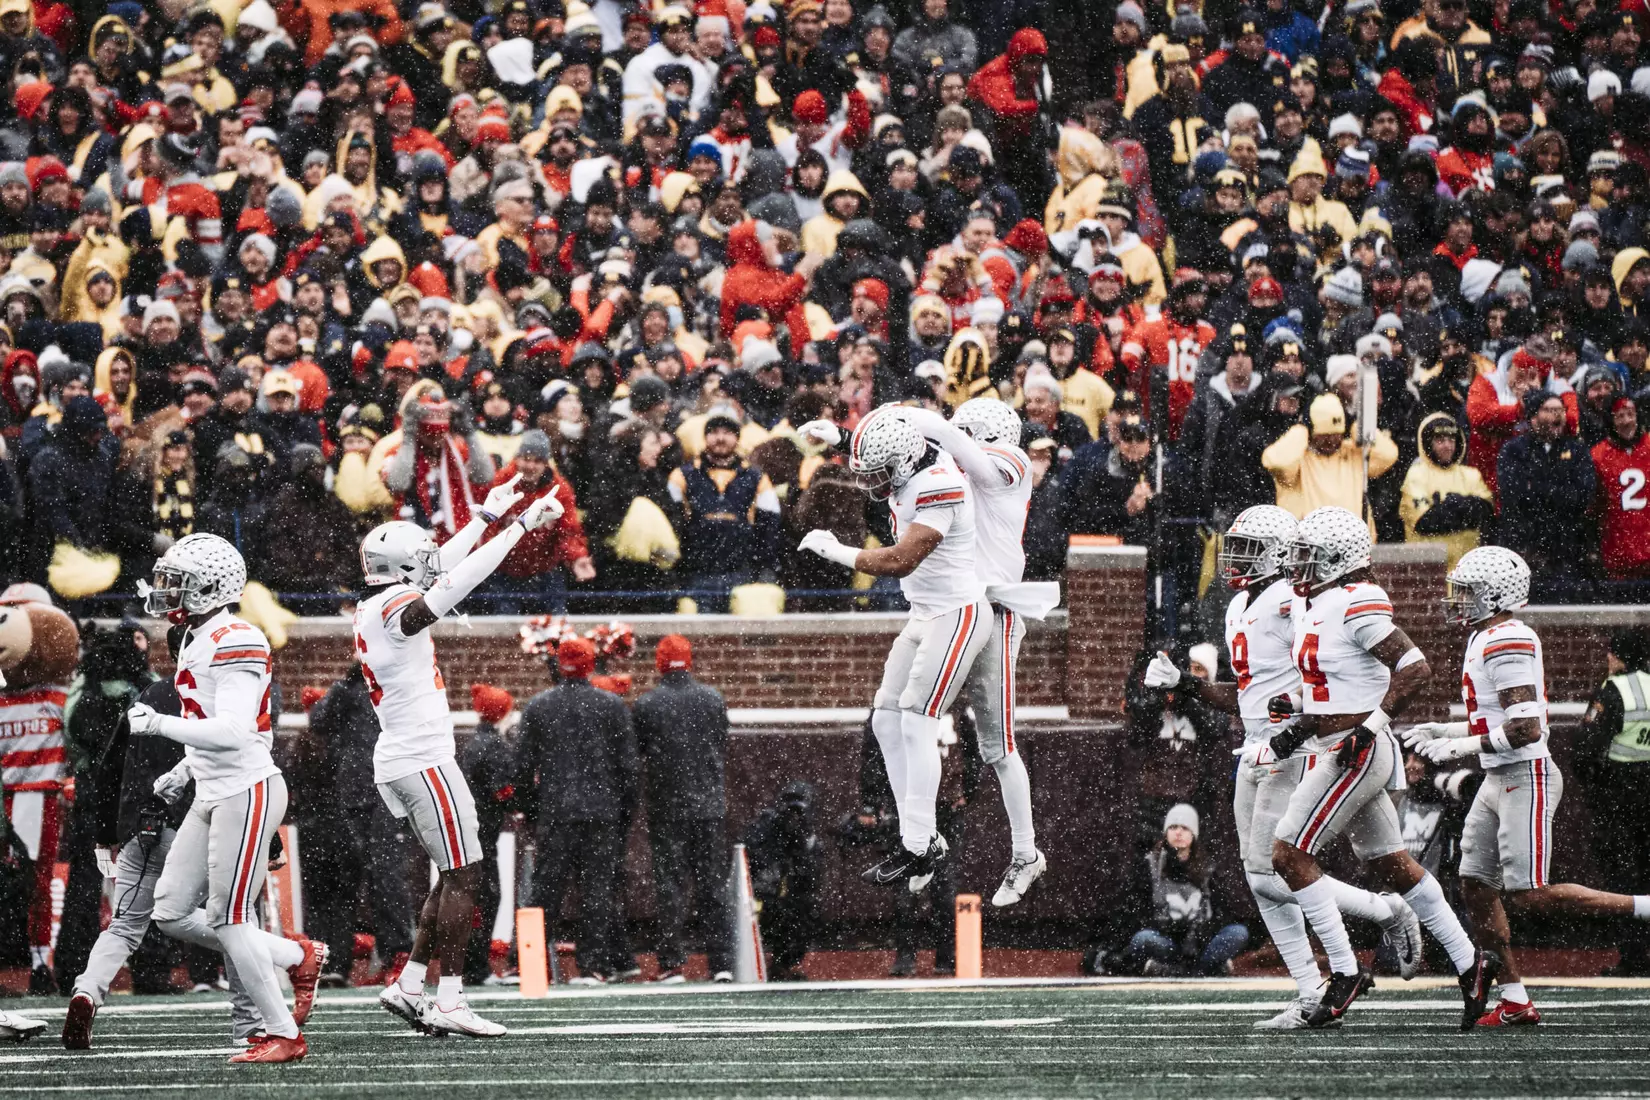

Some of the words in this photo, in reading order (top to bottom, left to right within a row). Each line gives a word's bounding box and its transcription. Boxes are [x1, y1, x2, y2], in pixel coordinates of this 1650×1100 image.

[1167, 337, 1200, 382] 16
[1619, 467, 1648, 511] 2
[1232, 632, 1253, 691] 9
